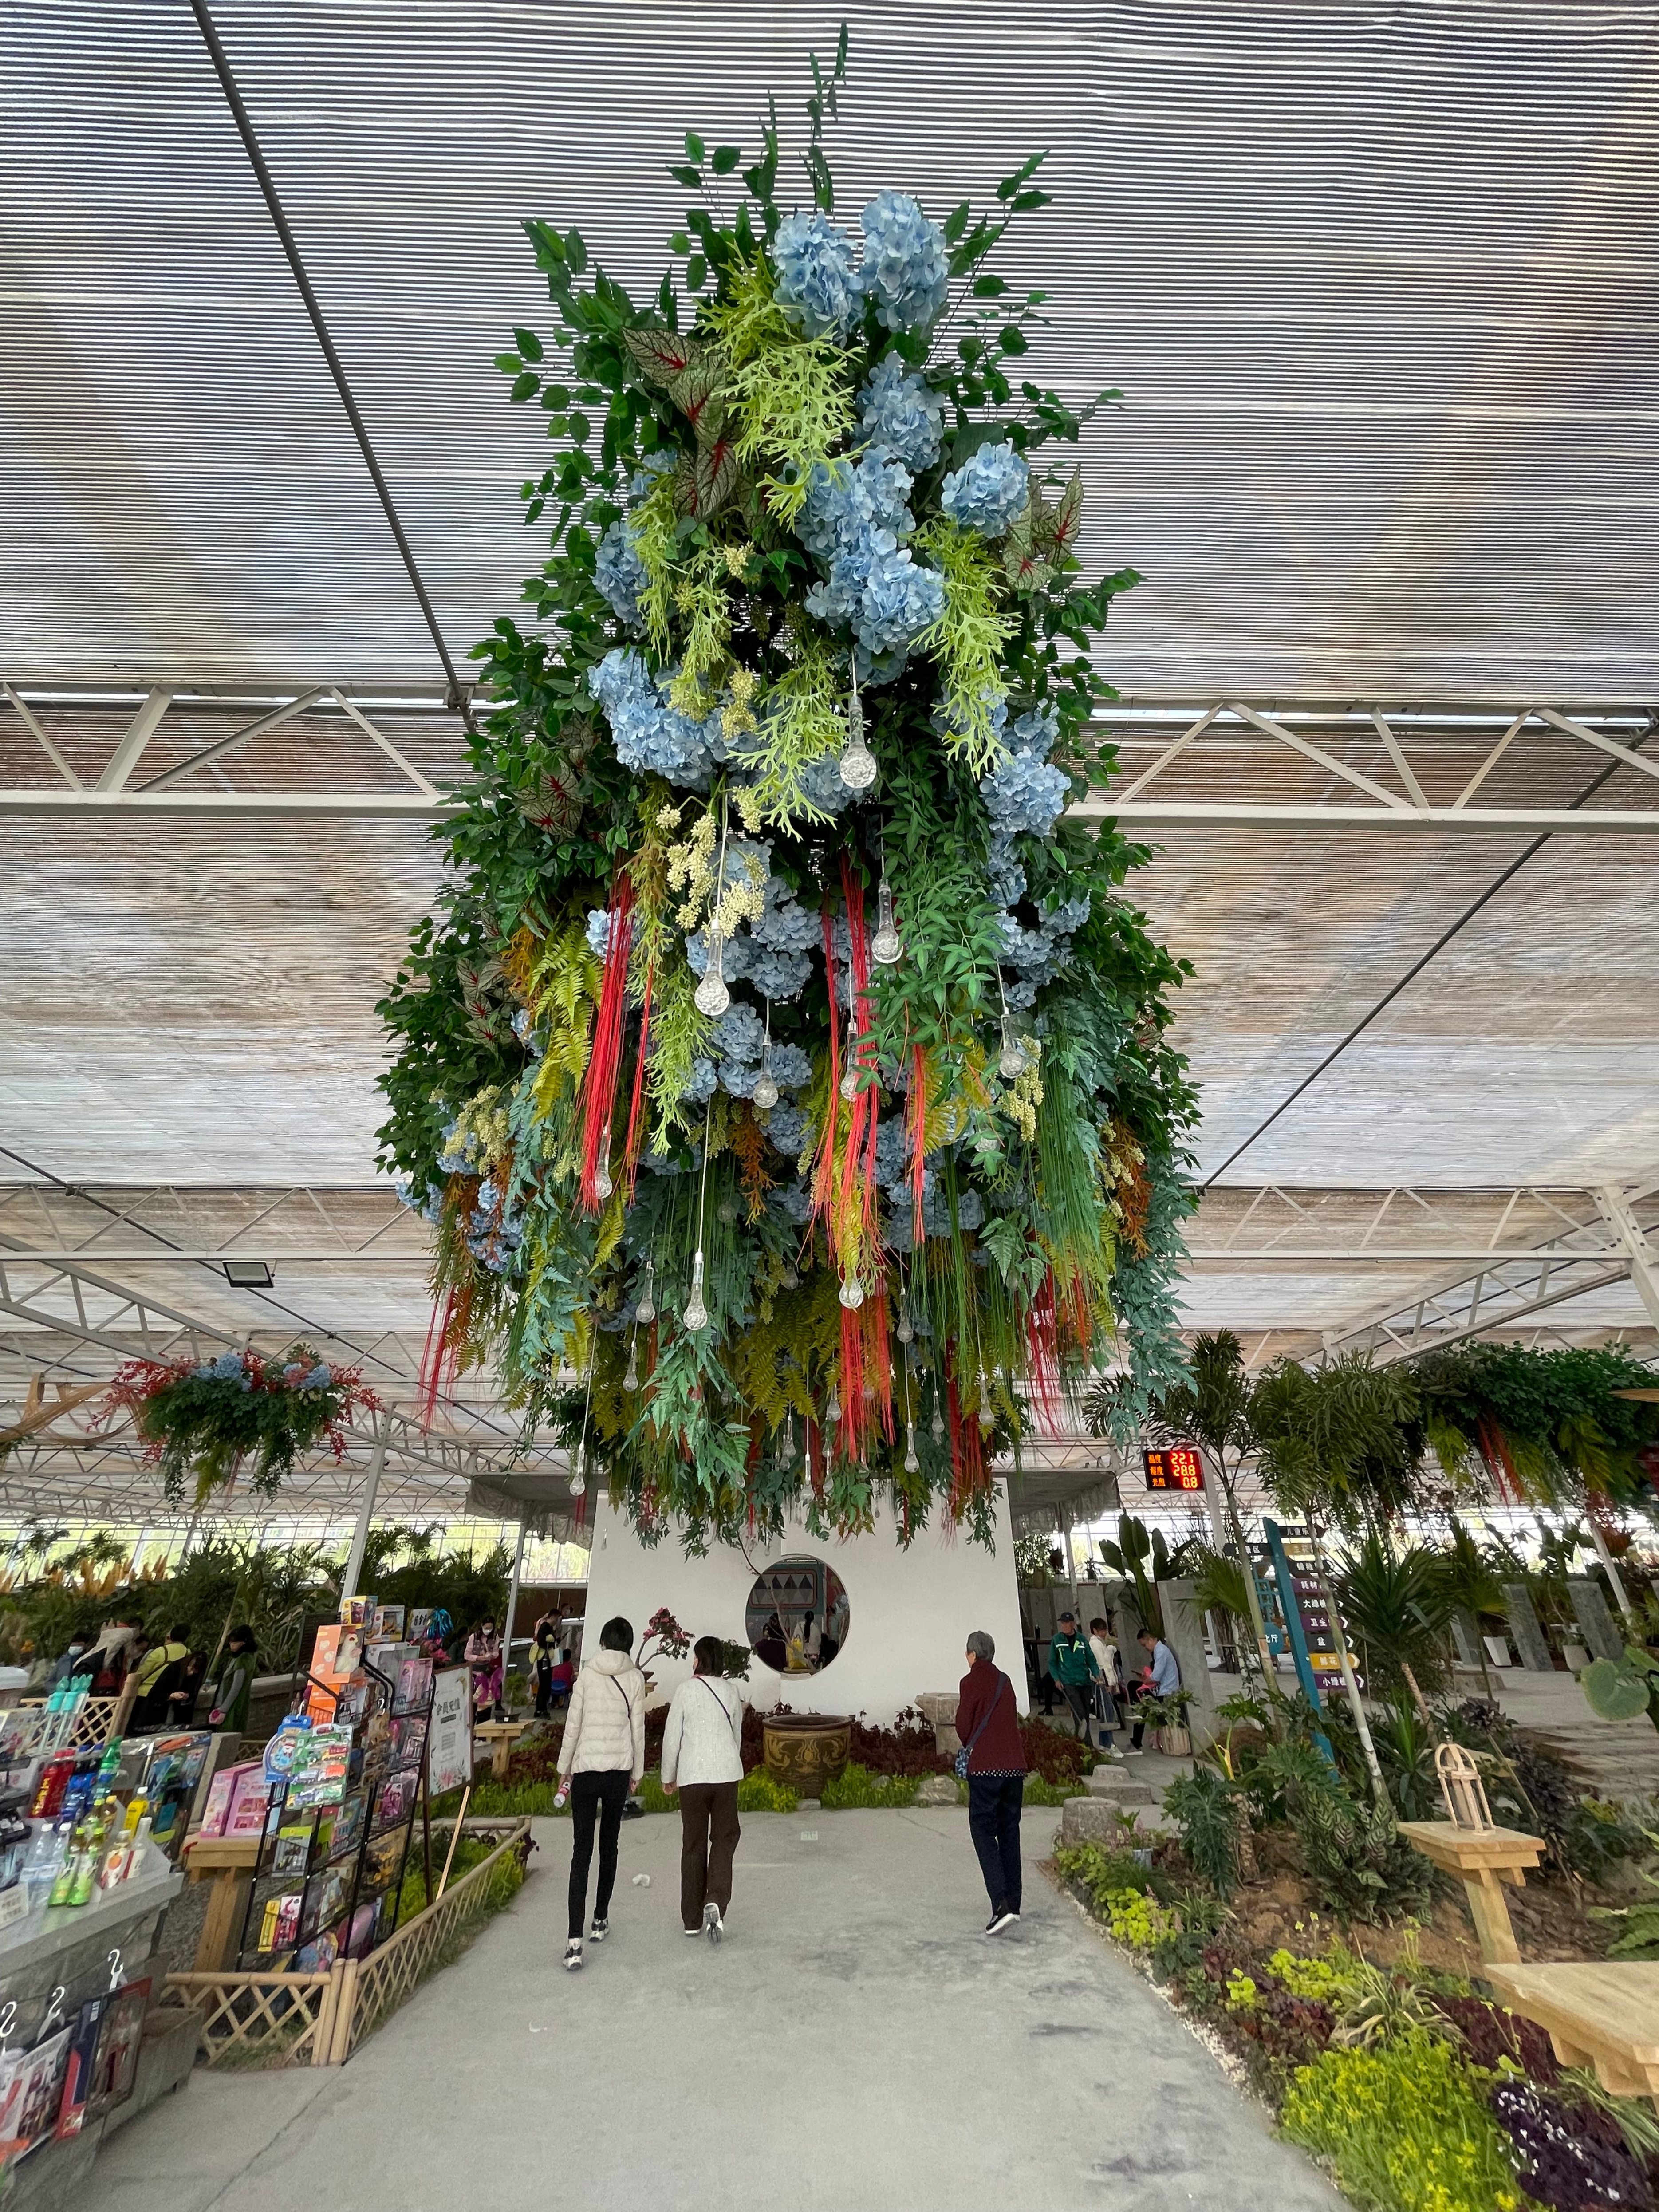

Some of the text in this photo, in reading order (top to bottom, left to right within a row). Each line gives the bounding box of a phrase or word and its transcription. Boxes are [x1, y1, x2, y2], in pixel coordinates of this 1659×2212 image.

[1171, 1453, 1194, 1464] 22.1
[1173, 1464, 1196, 1476] 28.8
[1183, 1476, 1198, 1488] 0.8
[1300, 1581, 1322, 1590] 耗材
[1310, 1617, 1332, 1627] 卫生
